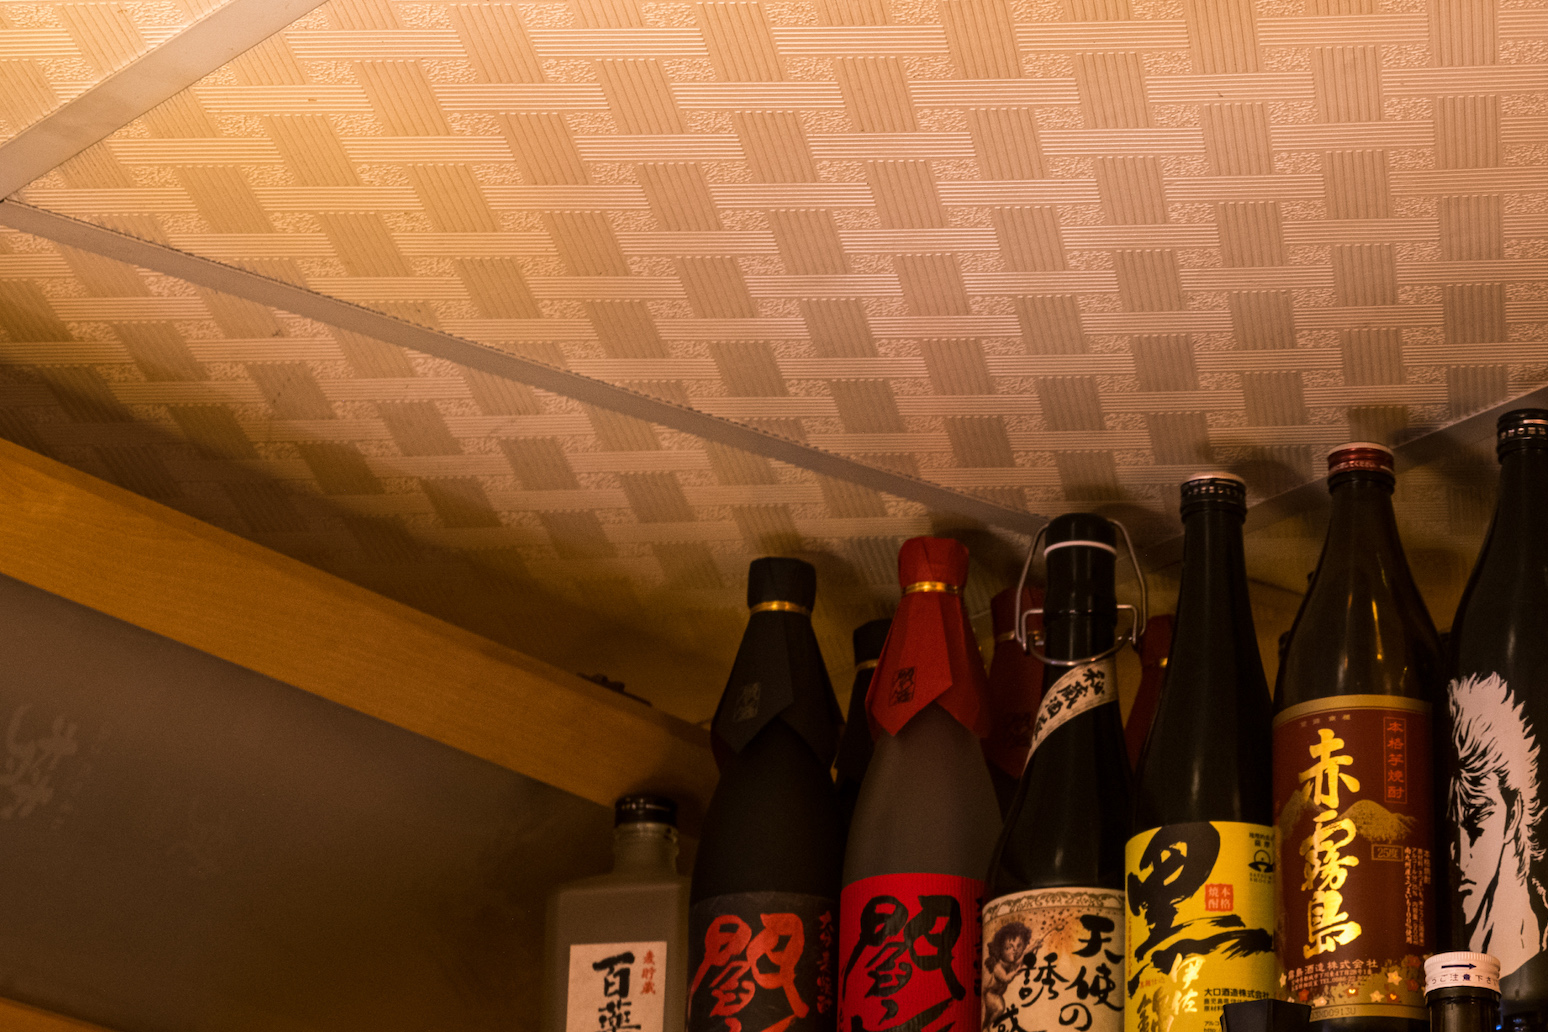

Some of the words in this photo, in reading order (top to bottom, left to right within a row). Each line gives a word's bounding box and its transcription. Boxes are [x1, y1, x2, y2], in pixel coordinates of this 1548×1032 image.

[1386, 720, 1404, 800] 本格芋焼酎
[1298, 728, 1362, 959] 赤霧島
[1127, 820, 1274, 1000] 黒
[1204, 988, 1269, 999] 大口酒造株式会社
